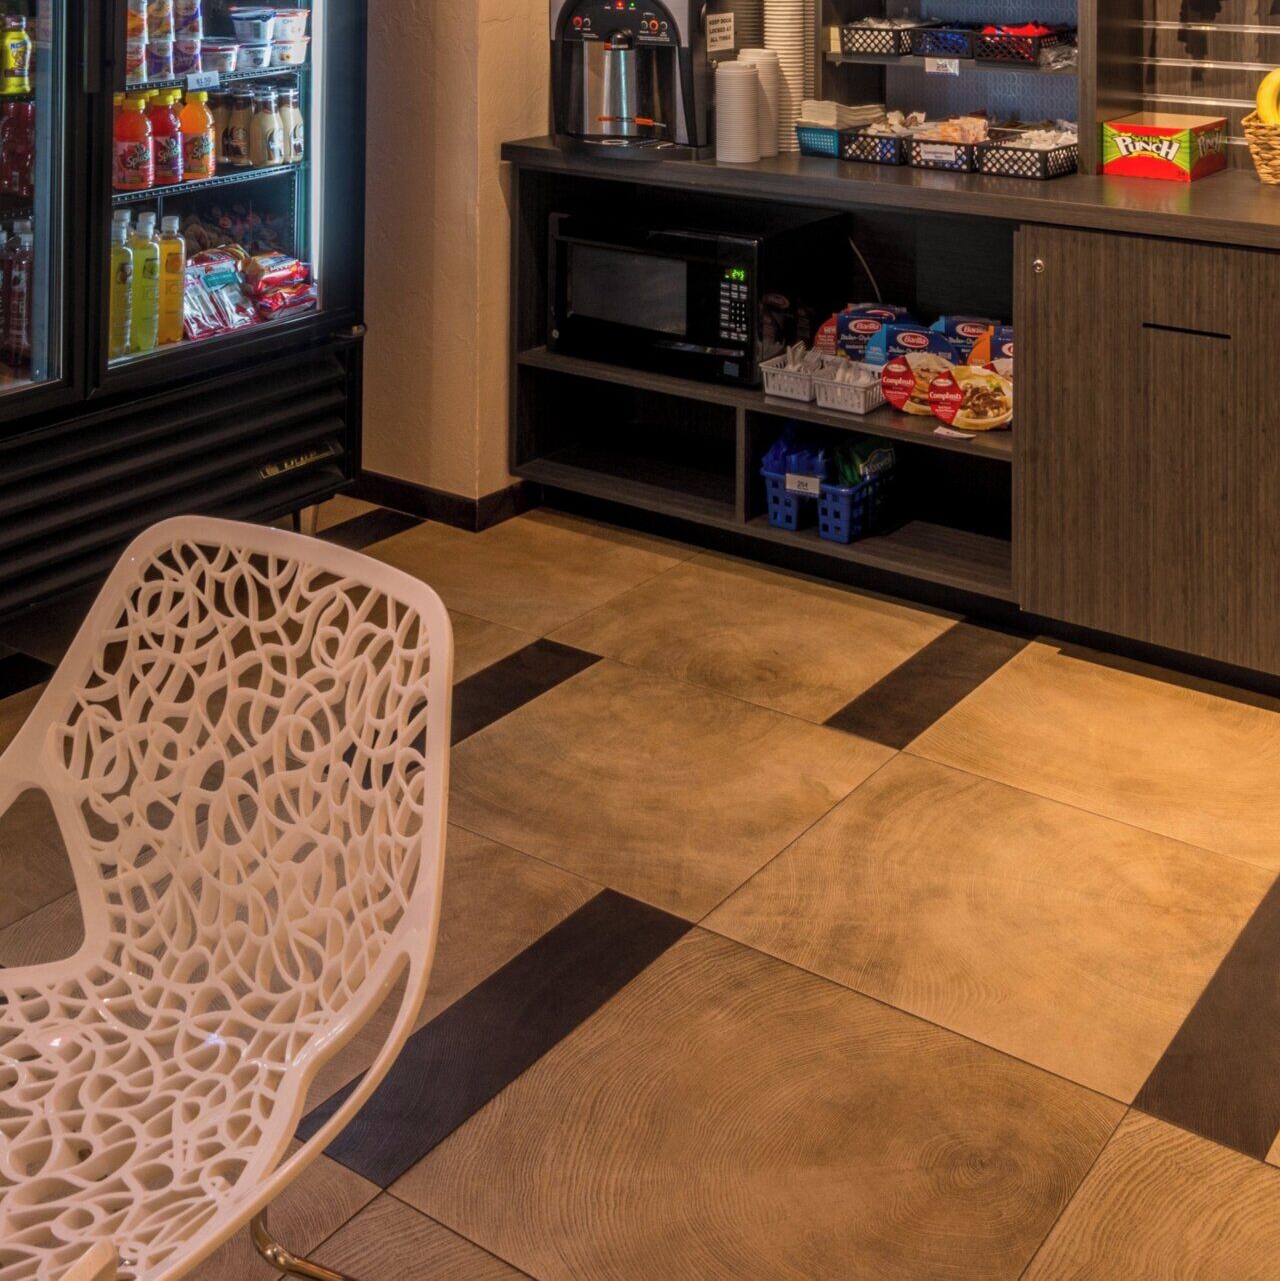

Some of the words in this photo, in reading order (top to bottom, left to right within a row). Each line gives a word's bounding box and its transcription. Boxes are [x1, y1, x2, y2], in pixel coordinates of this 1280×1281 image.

[1113, 135, 1181, 161] PUNCH
[855, 321, 881, 331] Barilla
[903, 335, 927, 345] Barilla
[929, 392, 962, 401] Compleats
